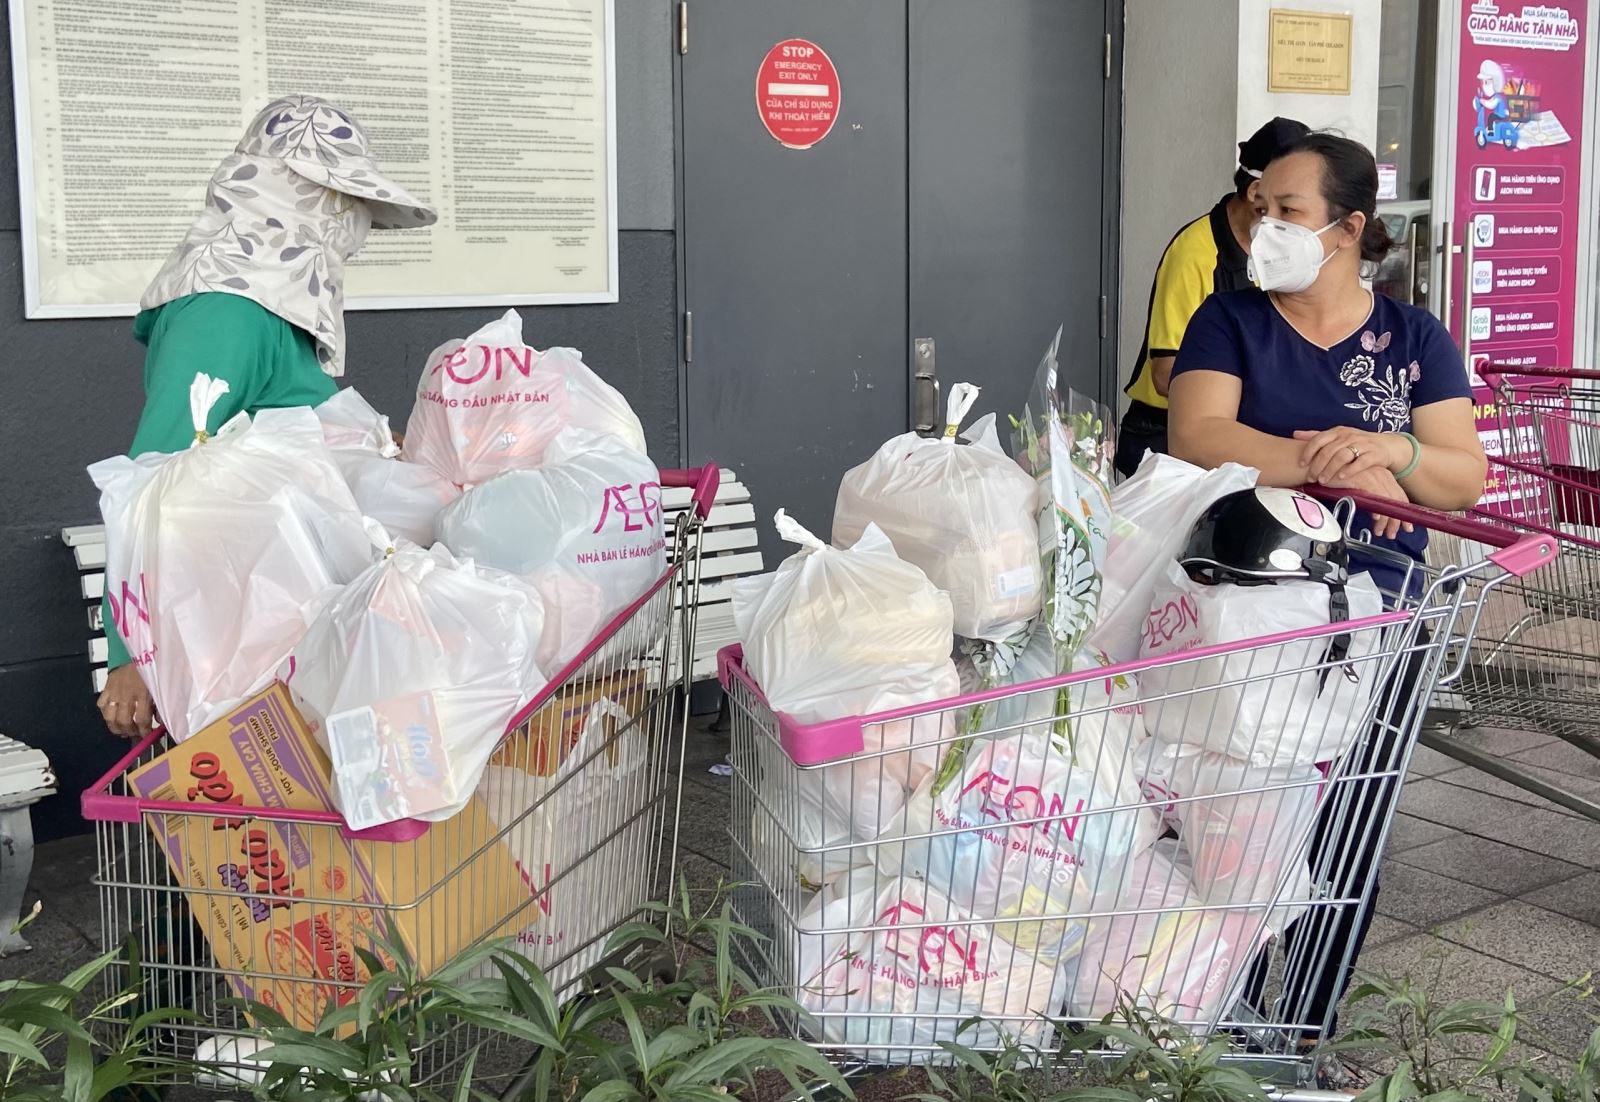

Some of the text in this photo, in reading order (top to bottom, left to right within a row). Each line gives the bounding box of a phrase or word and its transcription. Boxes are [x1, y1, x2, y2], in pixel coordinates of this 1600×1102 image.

[1469, 15, 1577, 38] GIAO HÀNG TẬN NHÀ
[783, 46, 814, 58] STOP
[774, 61, 822, 71] EMERGENCY
[797, 72, 818, 81] ONLY
[811, 101, 833, 110] DỤNG
[769, 110, 831, 121] KHI THOÁT HIỂM
[1473, 315, 1489, 324] Grab
[1473, 325, 1488, 334] Mart
[1522, 357, 1537, 365] AEON
[491, 392, 520, 405] NHẬT
[524, 391, 549, 402] BẢN
[577, 549, 600, 564] NHÀ
[249, 716, 270, 747] SHRIMP
[260, 710, 279, 741] Flavour
[238, 740, 256, 763] CAY
[265, 746, 282, 772] SOUR
[250, 762, 272, 793] CHUA
[280, 777, 294, 796] HOT
[954, 771, 1085, 842] AEON
[1012, 840, 1030, 854] ĐẦ
[231, 903, 243, 916] LY
